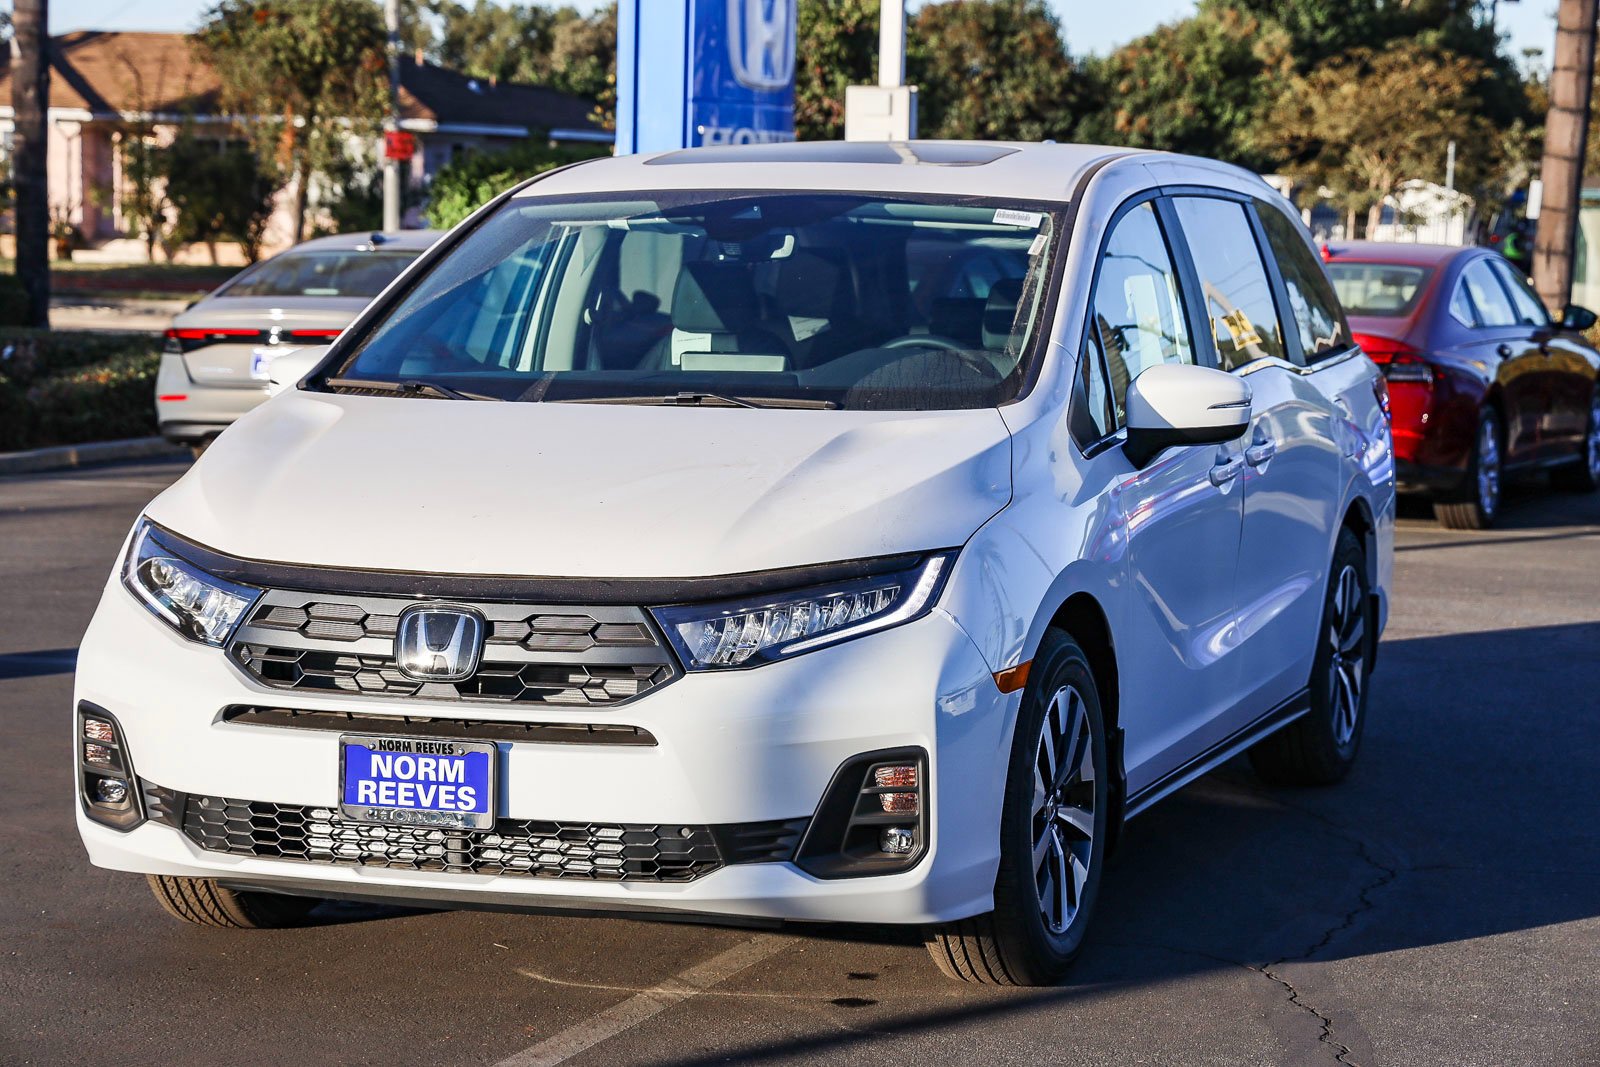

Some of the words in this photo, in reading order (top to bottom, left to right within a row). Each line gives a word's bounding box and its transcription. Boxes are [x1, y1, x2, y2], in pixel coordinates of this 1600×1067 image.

[379, 740, 412, 753] NORM
[416, 742, 454, 755] REEVES
[371, 754, 465, 783] NORM
[358, 780, 477, 811] REEVES
